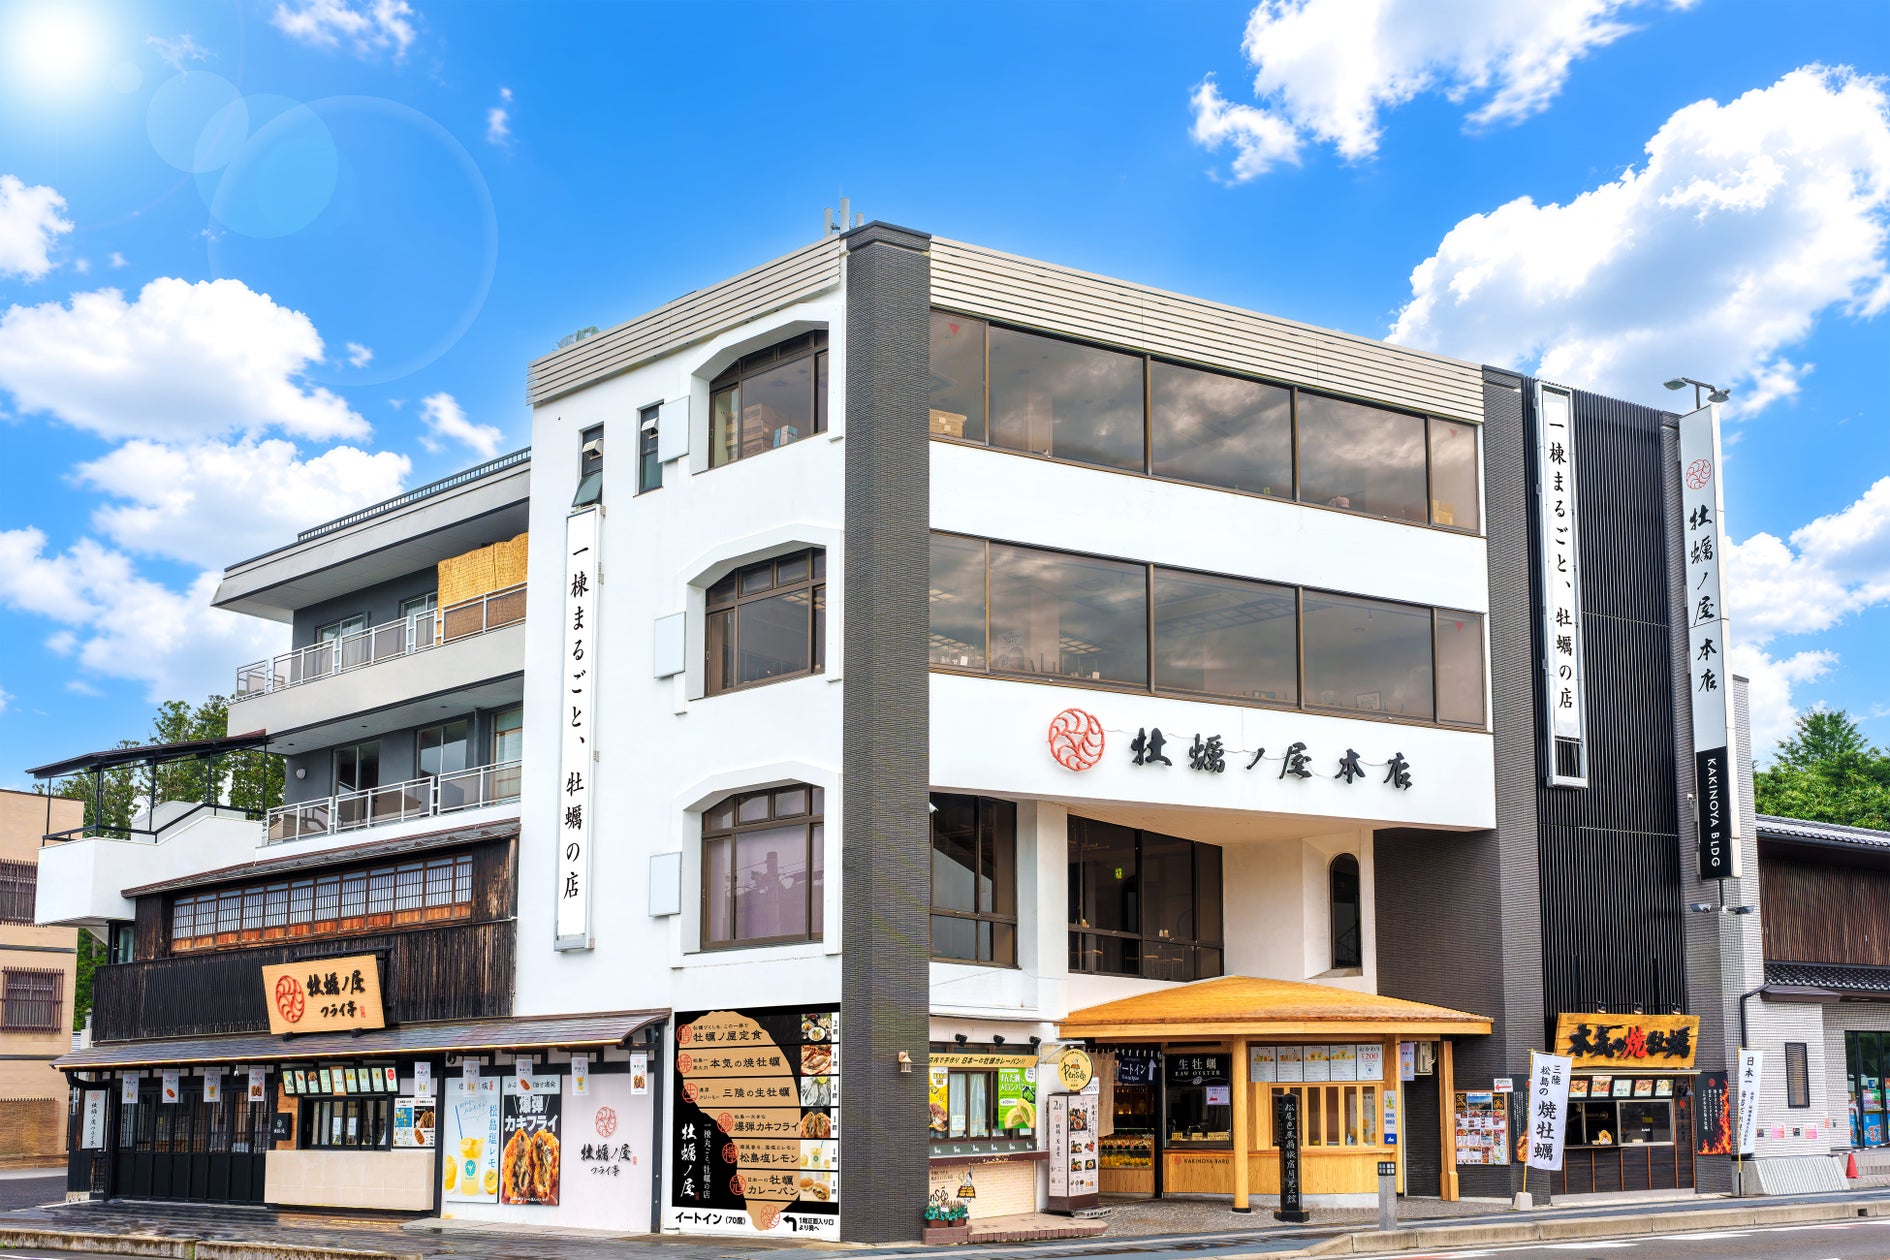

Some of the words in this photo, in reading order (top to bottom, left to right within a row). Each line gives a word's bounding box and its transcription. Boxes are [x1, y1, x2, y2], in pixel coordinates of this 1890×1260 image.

[1548, 421, 1574, 709] 一棟まるごと、牡蠣の店
[1689, 506, 1718, 694] 牡蠣ノ屋本店
[563, 546, 590, 900] 一棟まるごと、牡蠣の店
[1130, 727, 1412, 791] 牡蠣ノ屋本店
[1706, 757, 1718, 828] KAKINOYA
[1710, 832, 1721, 867] BLDG
[307, 969, 366, 997] 牡蠣ノ屋
[320, 1000, 357, 1018] フライ亭
[693, 1031, 763, 1042] 牡蠣ノ屋定食
[1567, 1023, 1691, 1059] 本気の焼牡蠣
[710, 1056, 781, 1069] 本気の焼牡蠣
[1178, 1058, 1217, 1070] 生牡蠣
[1539, 1065, 1550, 1096] 松島の
[1551, 1065, 1562, 1086] 三陸
[722, 1086, 791, 1098] 三陸の生牡蠣
[504, 1114, 559, 1132] カキフライ
[734, 1122, 800, 1132] 爆弾カキフライ
[1534, 1100, 1557, 1162] 焼牡蠣
[488, 1104, 498, 1181] 松島塩レモン
[580, 1144, 631, 1162] 牡蠣ノ屋
[680, 1123, 699, 1197] 牡蠣ノ屋
[739, 1152, 800, 1164] 松島塩レモン
[748, 1186, 799, 1196] カレーパン
[675, 1212, 723, 1225] イートイン
